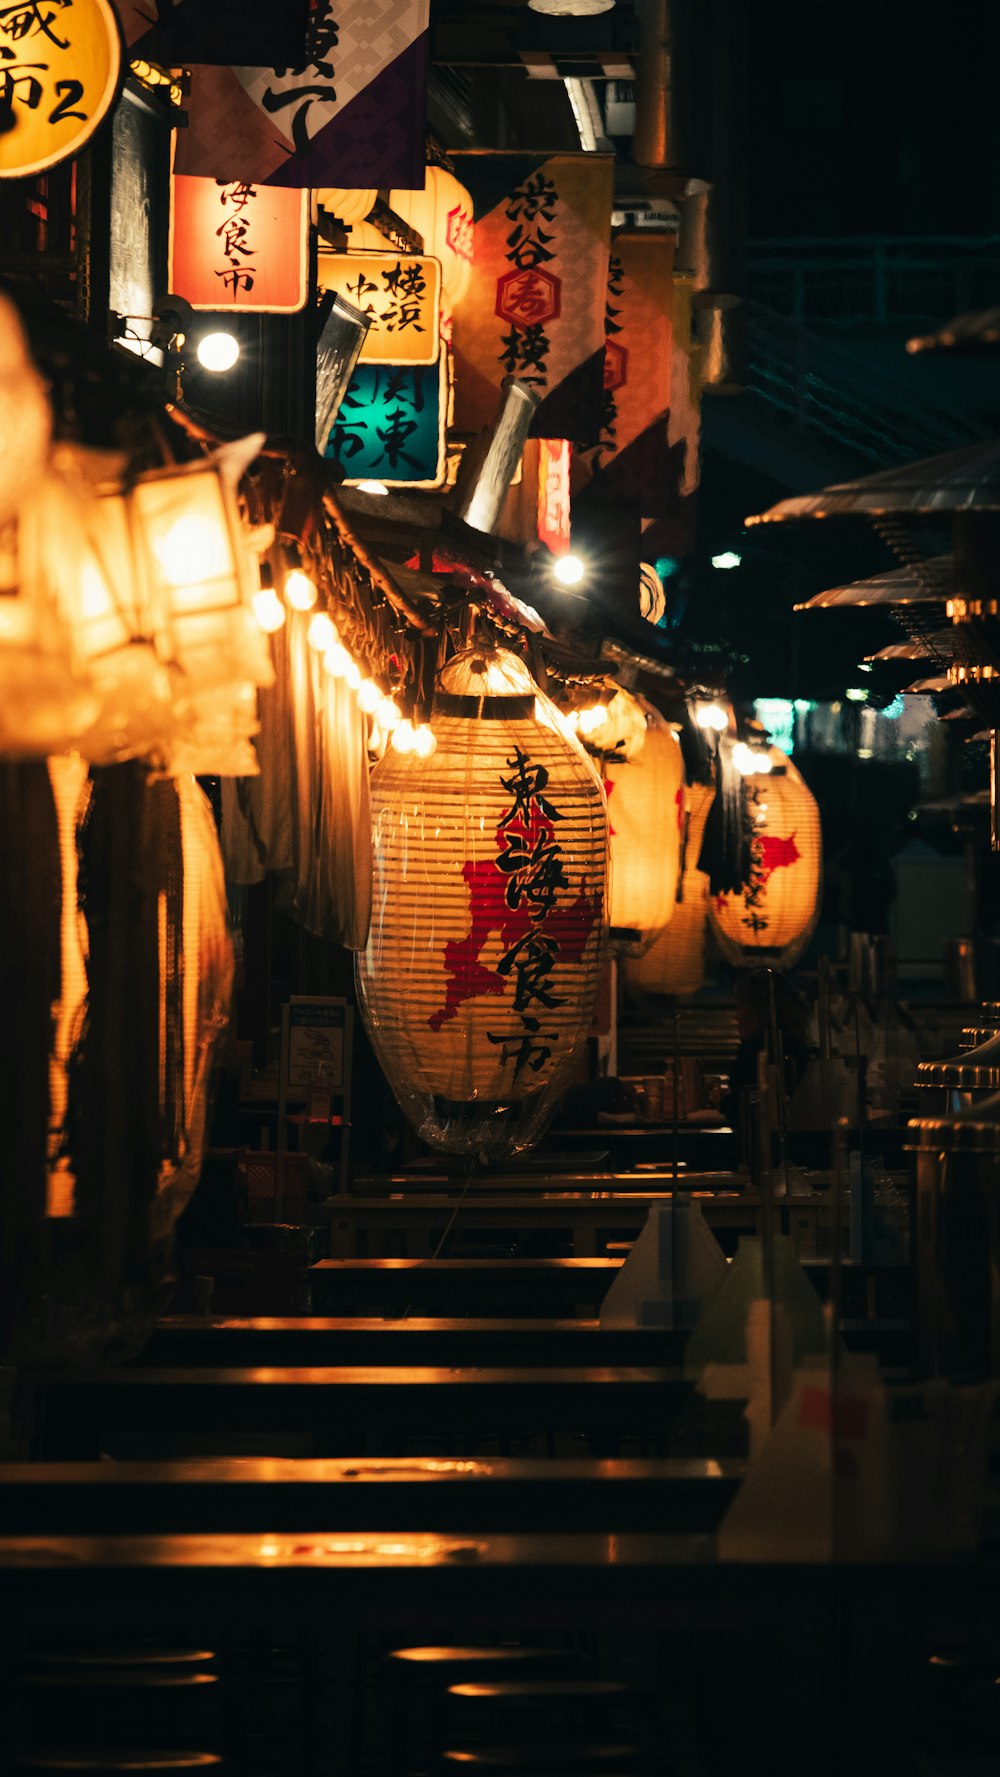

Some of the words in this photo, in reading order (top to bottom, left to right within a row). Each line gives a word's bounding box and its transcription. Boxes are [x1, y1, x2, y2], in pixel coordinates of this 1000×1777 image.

[380, 261, 428, 333] 横浜
[486, 744, 569, 1087] 東海食市
